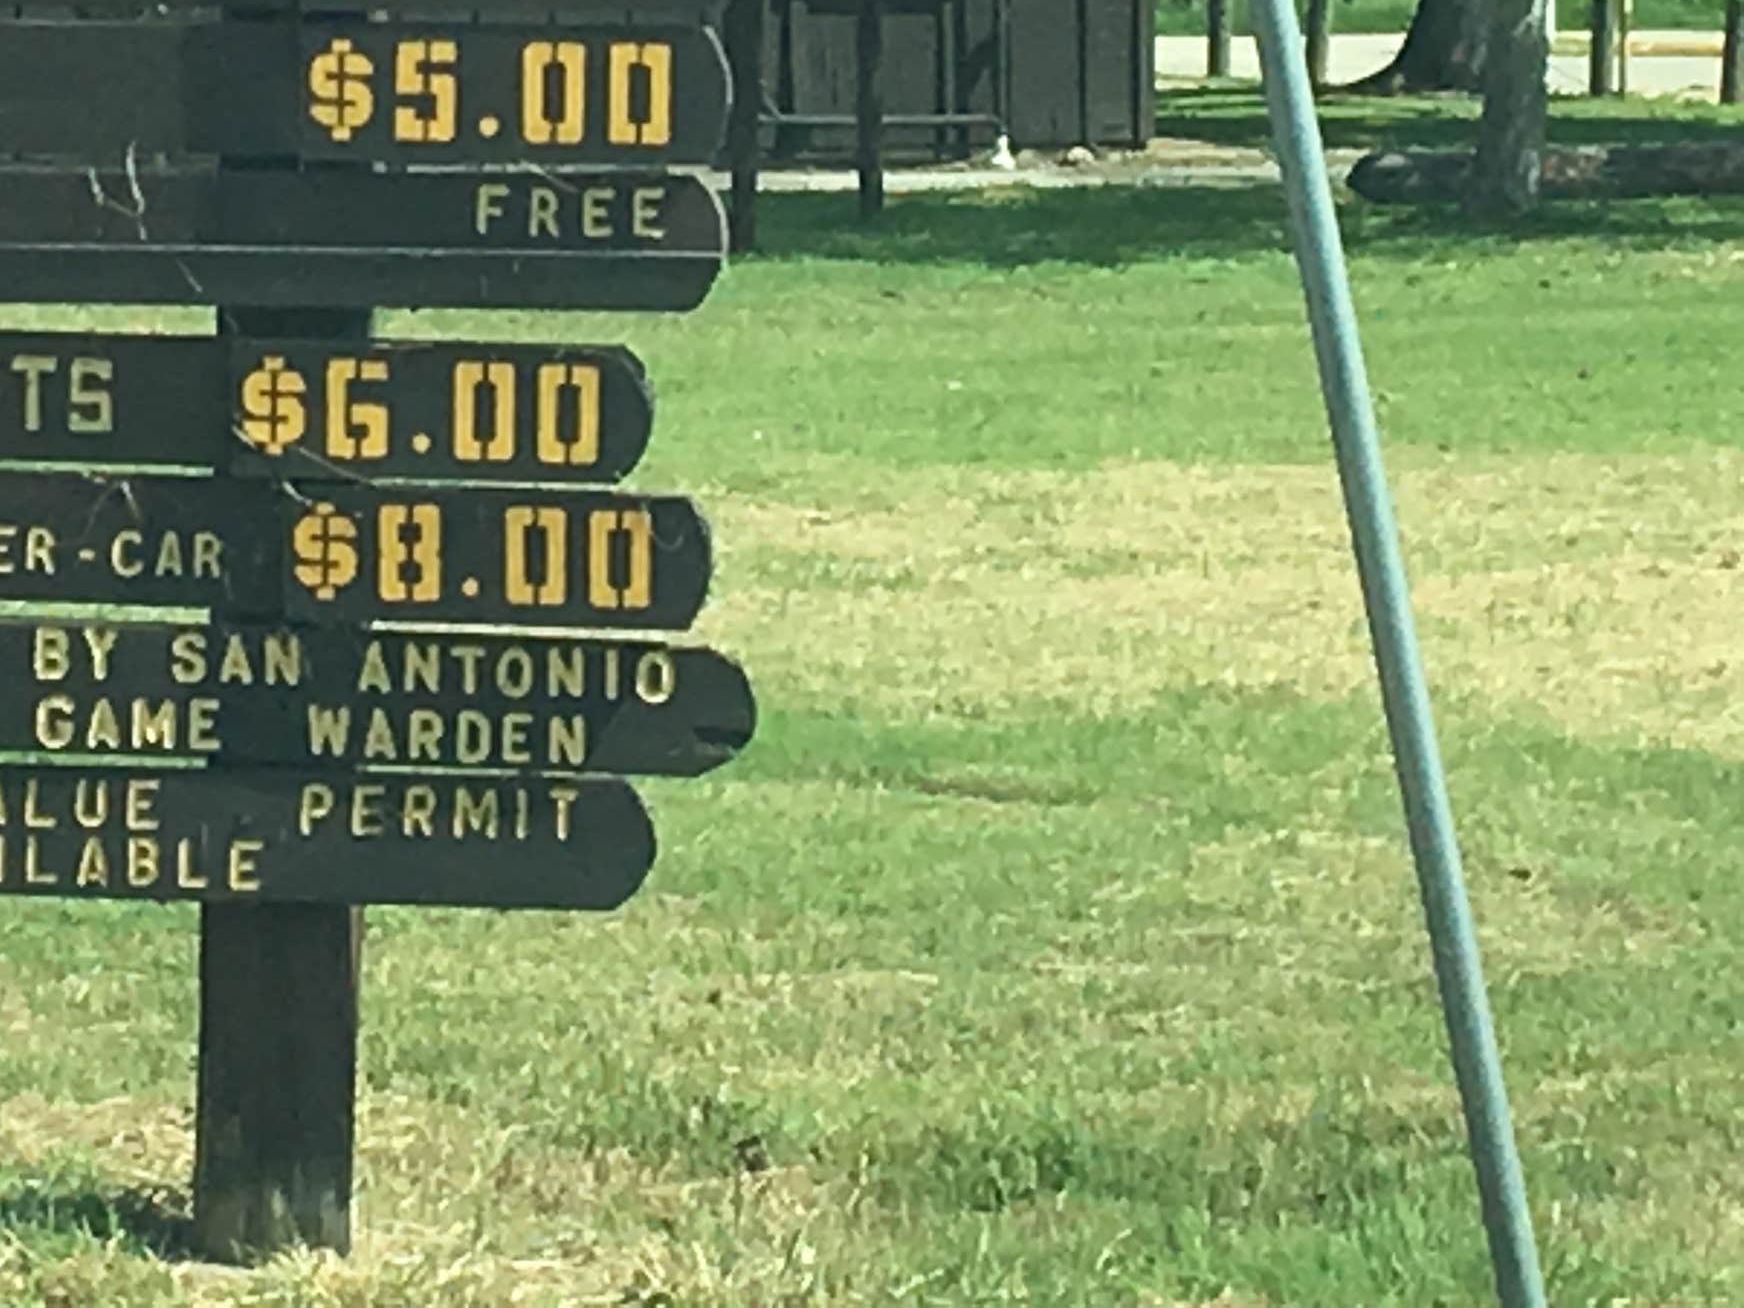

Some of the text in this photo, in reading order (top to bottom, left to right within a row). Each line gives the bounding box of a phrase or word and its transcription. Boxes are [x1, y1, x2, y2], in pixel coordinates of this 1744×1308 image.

[308, 39, 672, 145] $5.00
[475, 186, 666, 239] FREE
[240, 355, 600, 464] $6.00
[293, 501, 652, 610] $8.00
[33, 626, 117, 682] BY
[171, 632, 302, 687] SAN
[358, 647, 676, 705] ANTONIO
[35, 697, 221, 752] GAME
[307, 704, 587, 766] WARDEN
[298, 783, 580, 842] PERMIT
